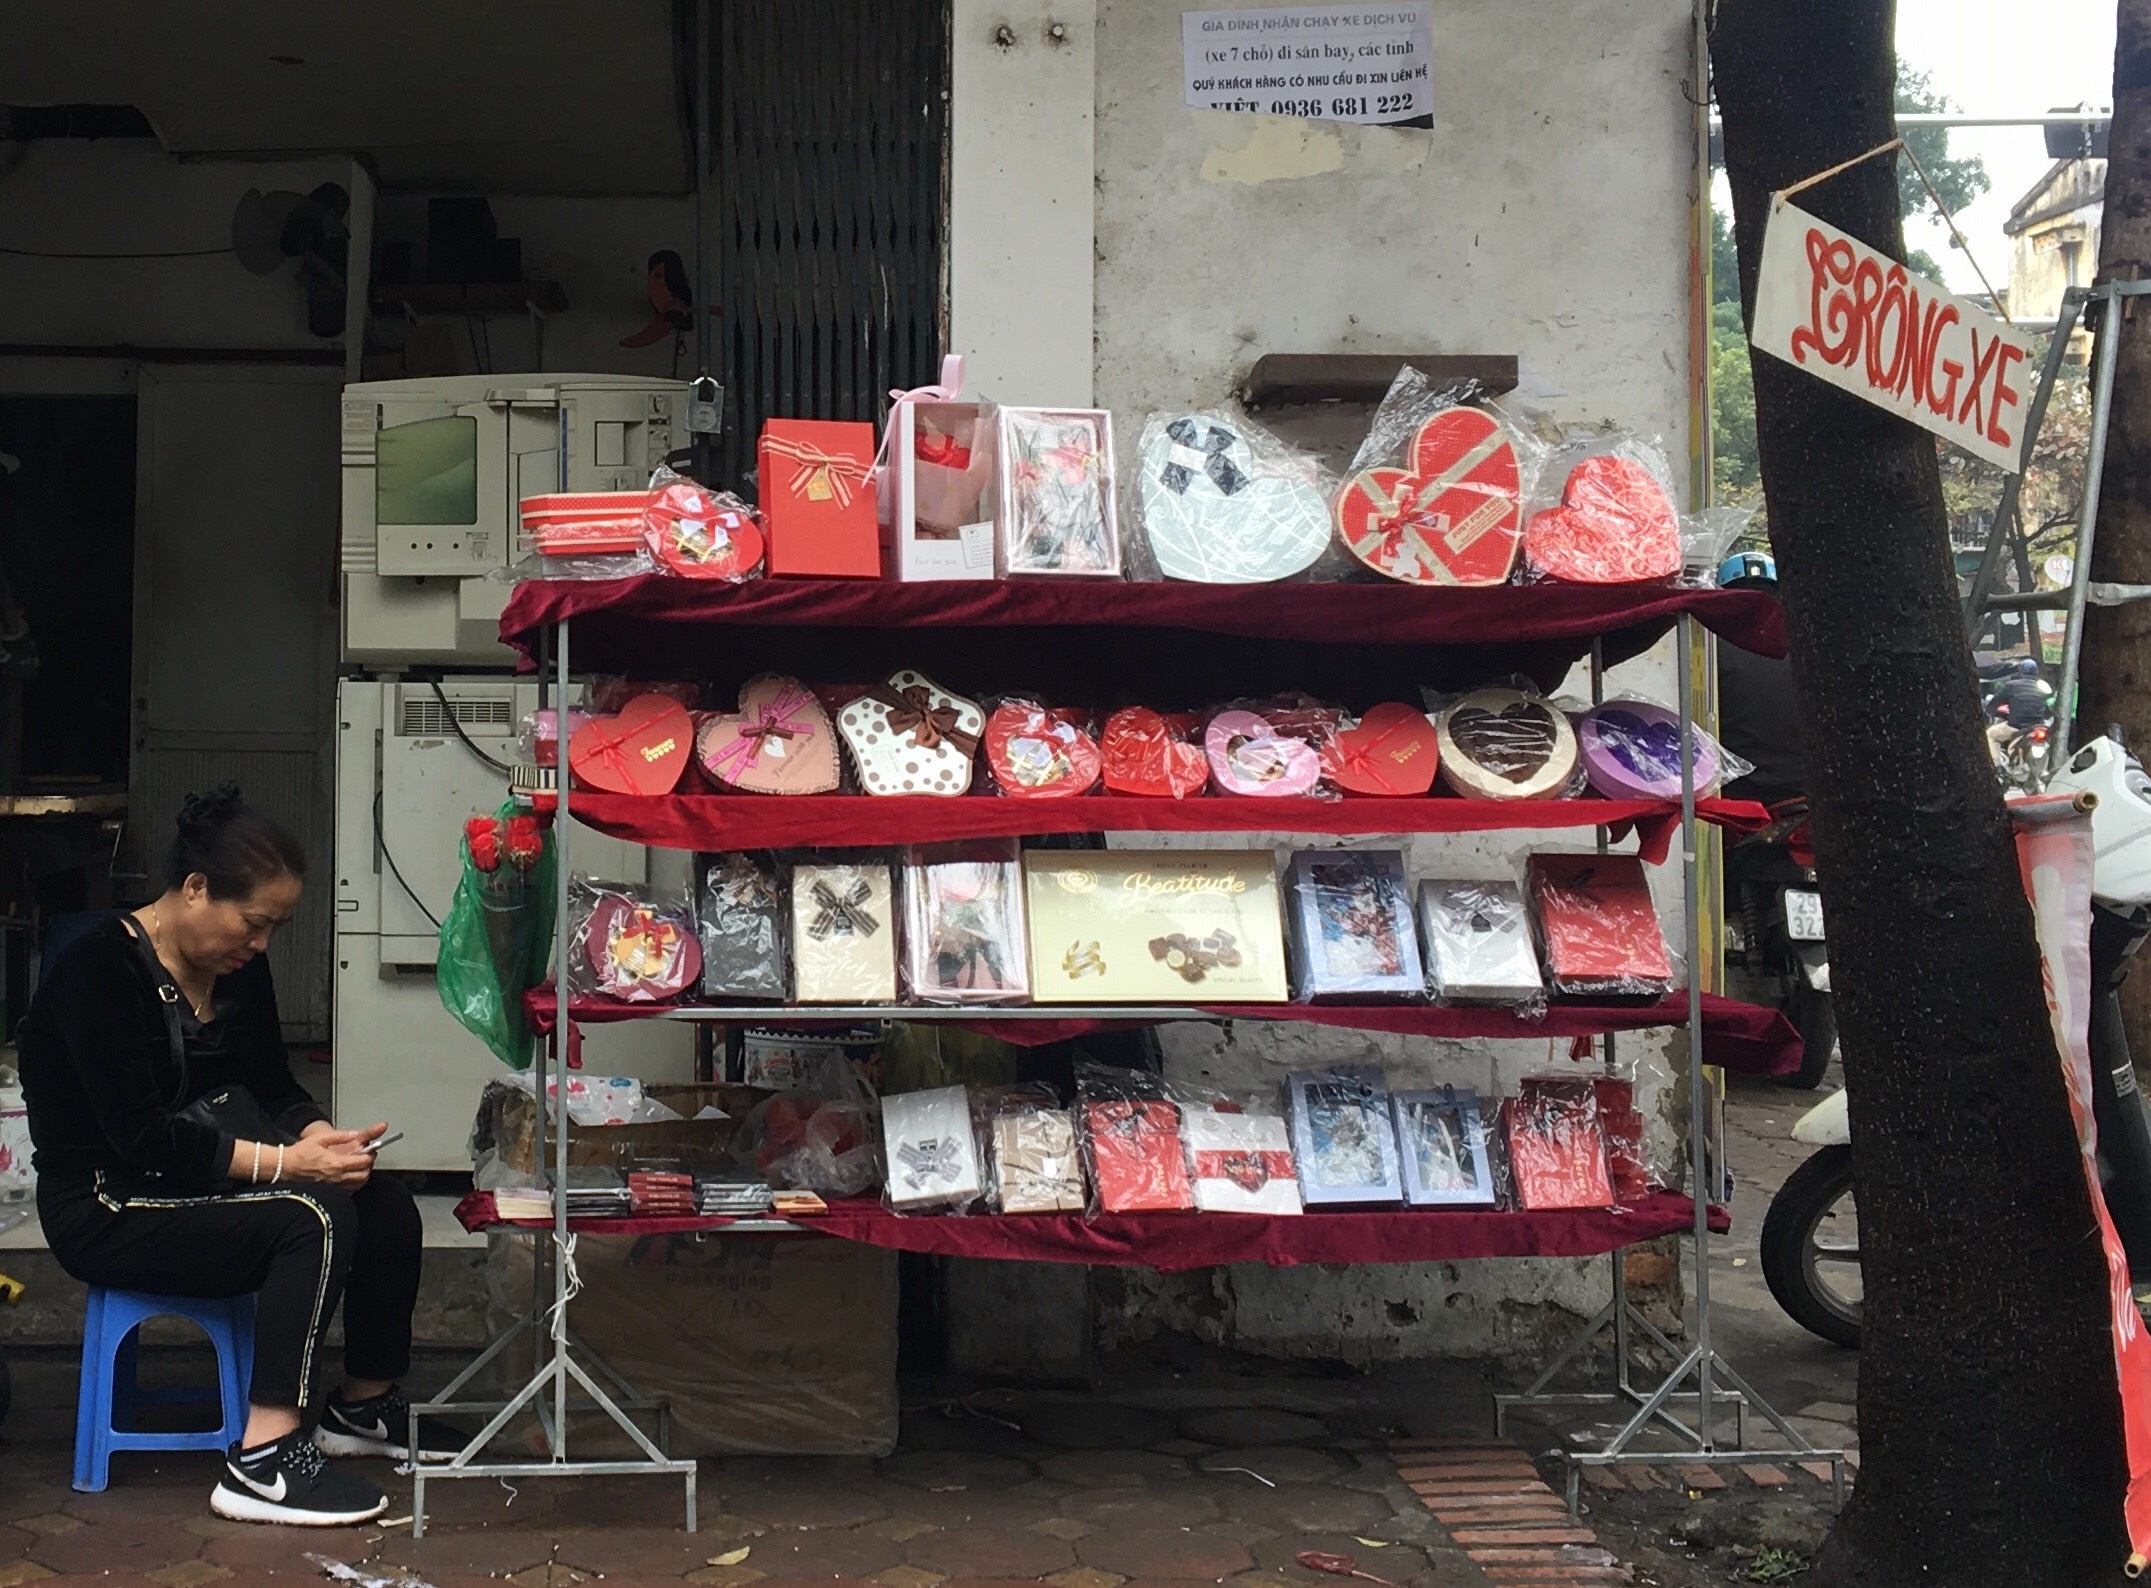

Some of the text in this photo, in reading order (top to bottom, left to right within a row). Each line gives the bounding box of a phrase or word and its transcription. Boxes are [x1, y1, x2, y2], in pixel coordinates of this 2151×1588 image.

[1201, 21, 1225, 32] GIA
[1342, 14, 1360, 26] XE
[1205, 48, 1228, 64] (xe
[1230, 47, 1239, 62] 7
[1277, 45, 1291, 60] đi
[1324, 43, 1355, 62] bay,
[1358, 41, 1382, 57] các
[1192, 77, 1216, 91] QUÝ
[1217, 75, 1253, 90] KHÁCH
[1255, 74, 1287, 89] HÀNG
[1289, 73, 1305, 88] CÓ
[1307, 75, 1330, 87] NHU
[1369, 72, 1388, 84] XIN
[1390, 68, 1413, 83] LIÊN
[1271, 98, 1323, 118] 0936
[1331, 96, 1368, 116] 681
[1376, 92, 1414, 114] 222
[1958, 325, 2025, 449] XE
[1118, 867, 1246, 908] Beatitude
